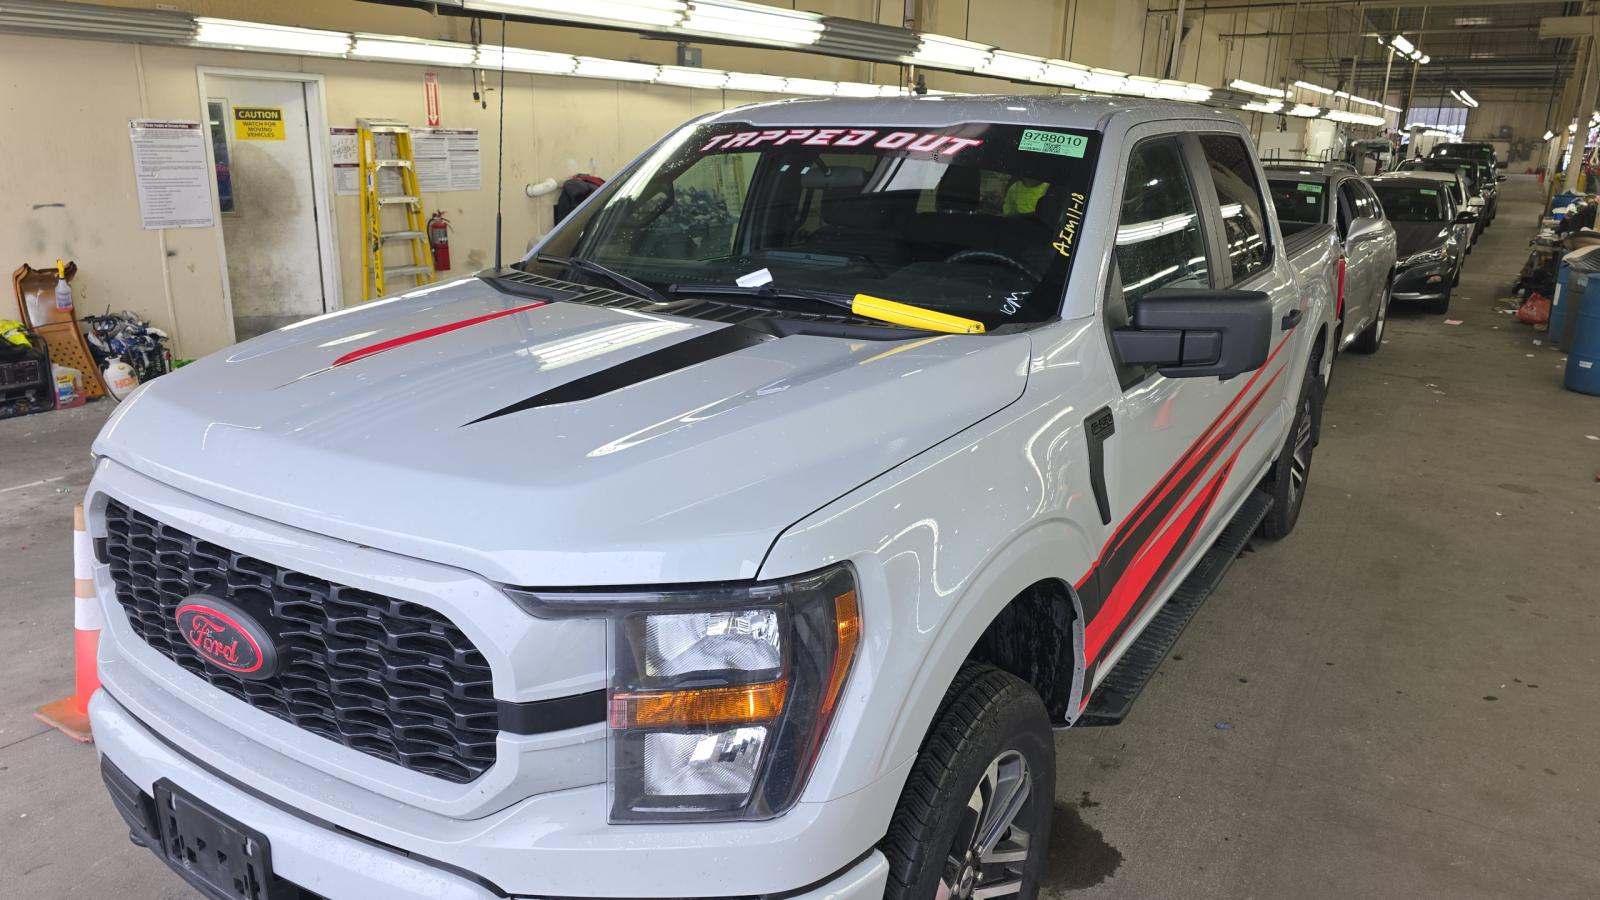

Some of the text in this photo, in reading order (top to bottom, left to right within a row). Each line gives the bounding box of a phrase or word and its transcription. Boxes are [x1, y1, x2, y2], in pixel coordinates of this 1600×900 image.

[239, 110, 278, 119] CAUTION
[700, 129, 984, 155] TAPPED OUT
[1024, 131, 1082, 147] 9788010
[189, 614, 240, 663] Ford
